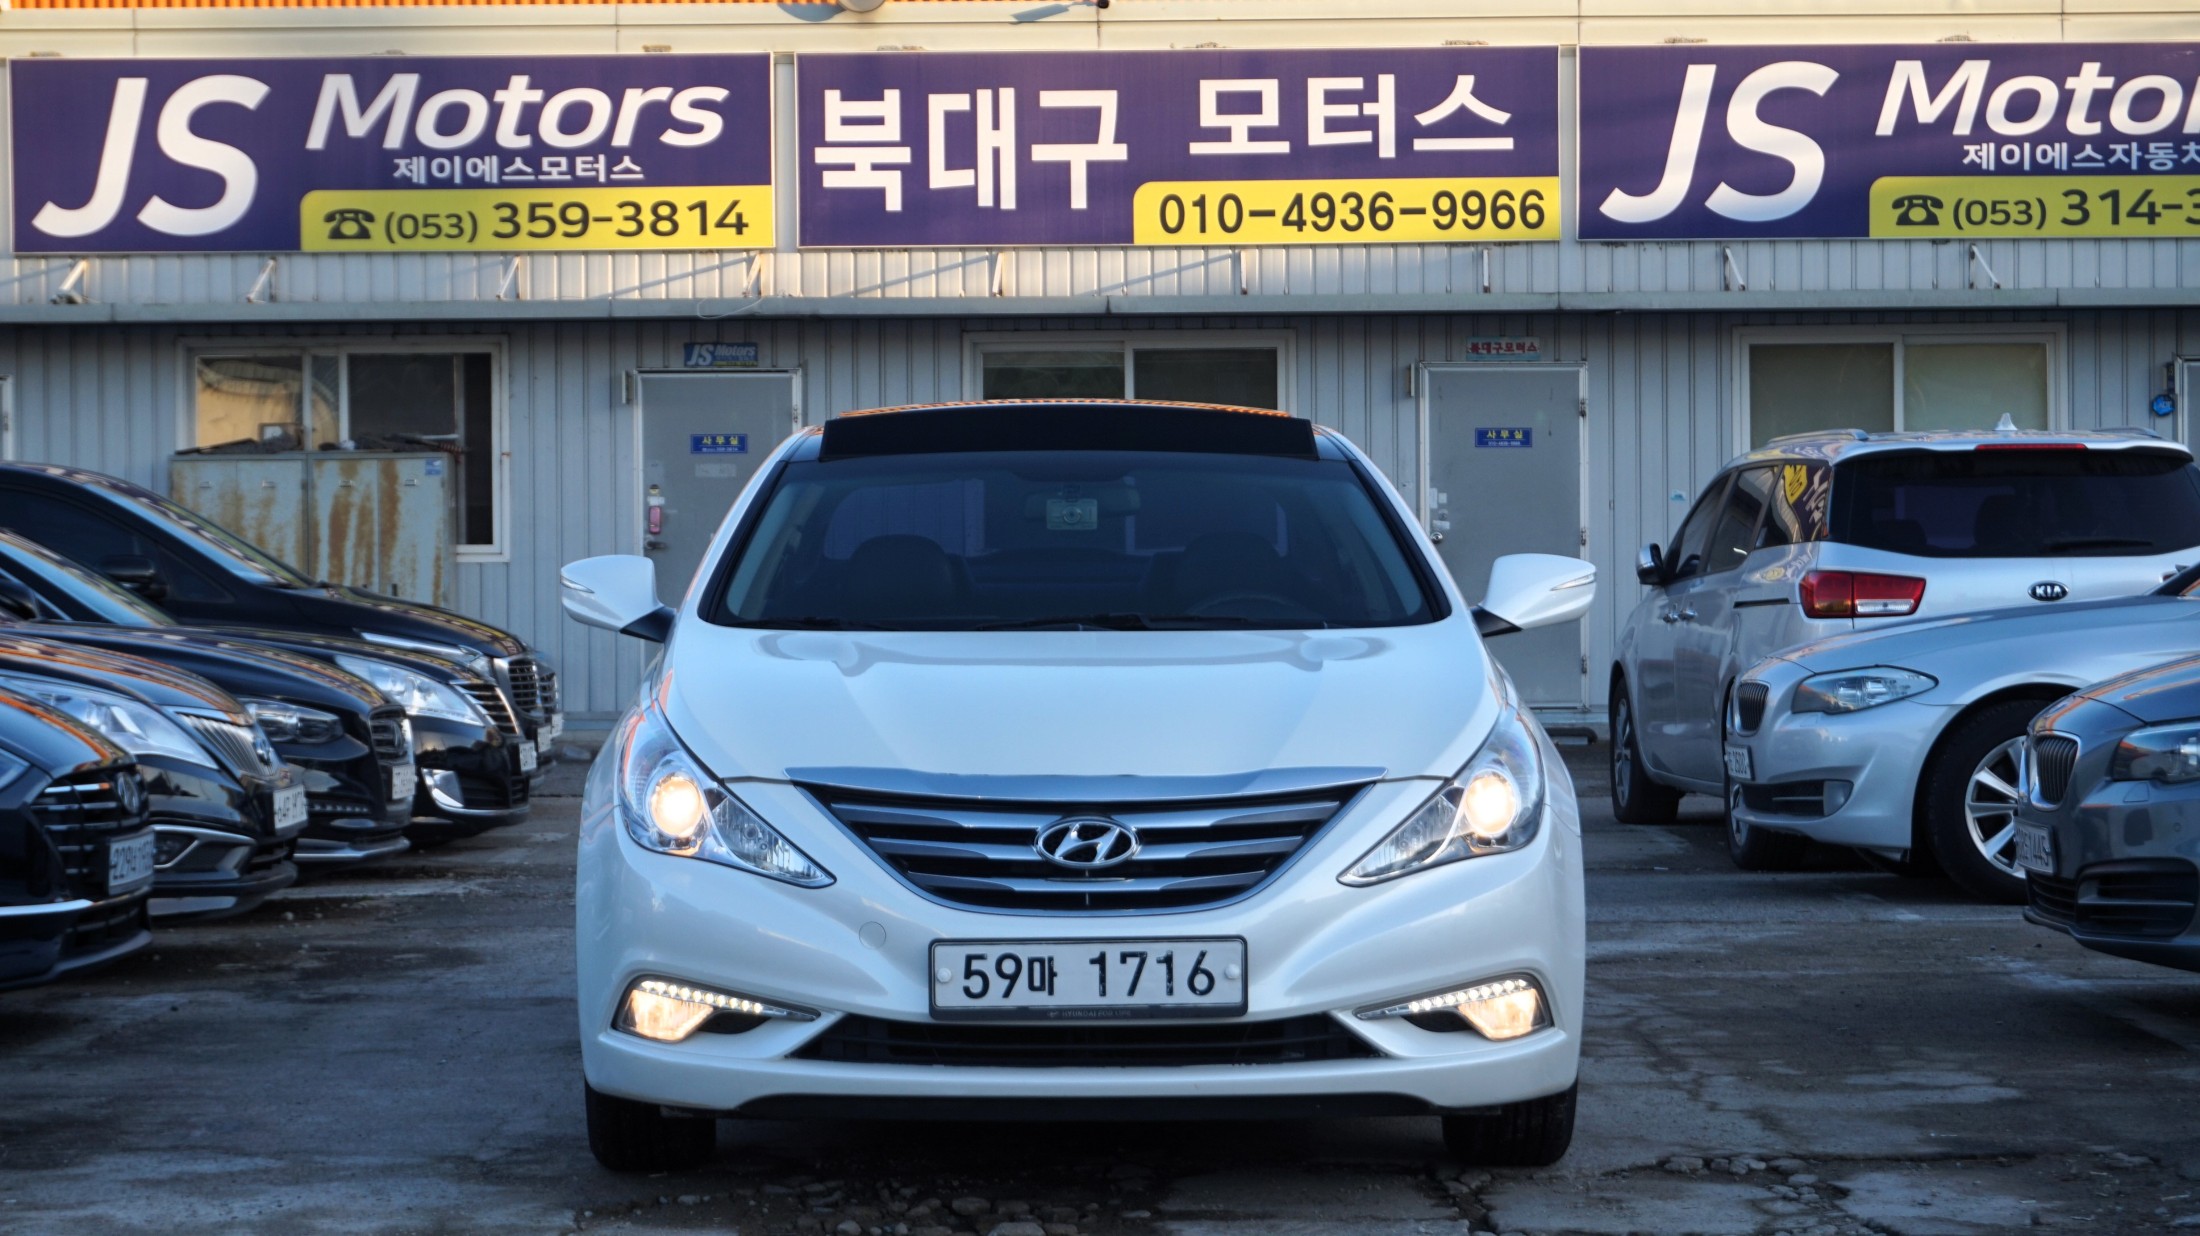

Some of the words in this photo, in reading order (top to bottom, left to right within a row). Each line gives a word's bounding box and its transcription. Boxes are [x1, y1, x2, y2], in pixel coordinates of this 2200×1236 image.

[32, 75, 271, 238] JS
[305, 73, 731, 150] Motors
[814, 87, 1128, 212] 북대구
[1189, 73, 1514, 159] 모터스
[1599, 60, 1840, 223] JS
[393, 153, 644, 184] 제이에스모터스
[384, 210, 478, 245] (053)
[491, 199, 749, 240] 359-3814
[1159, 189, 1545, 235] 010-4936-9966
[1952, 197, 2047, 231] (053)
[686, 344, 714, 365] JS
[2035, 585, 2062, 597] KIA
[962, 952, 1058, 1000] 59마
[1088, 950, 1216, 998] 1716
